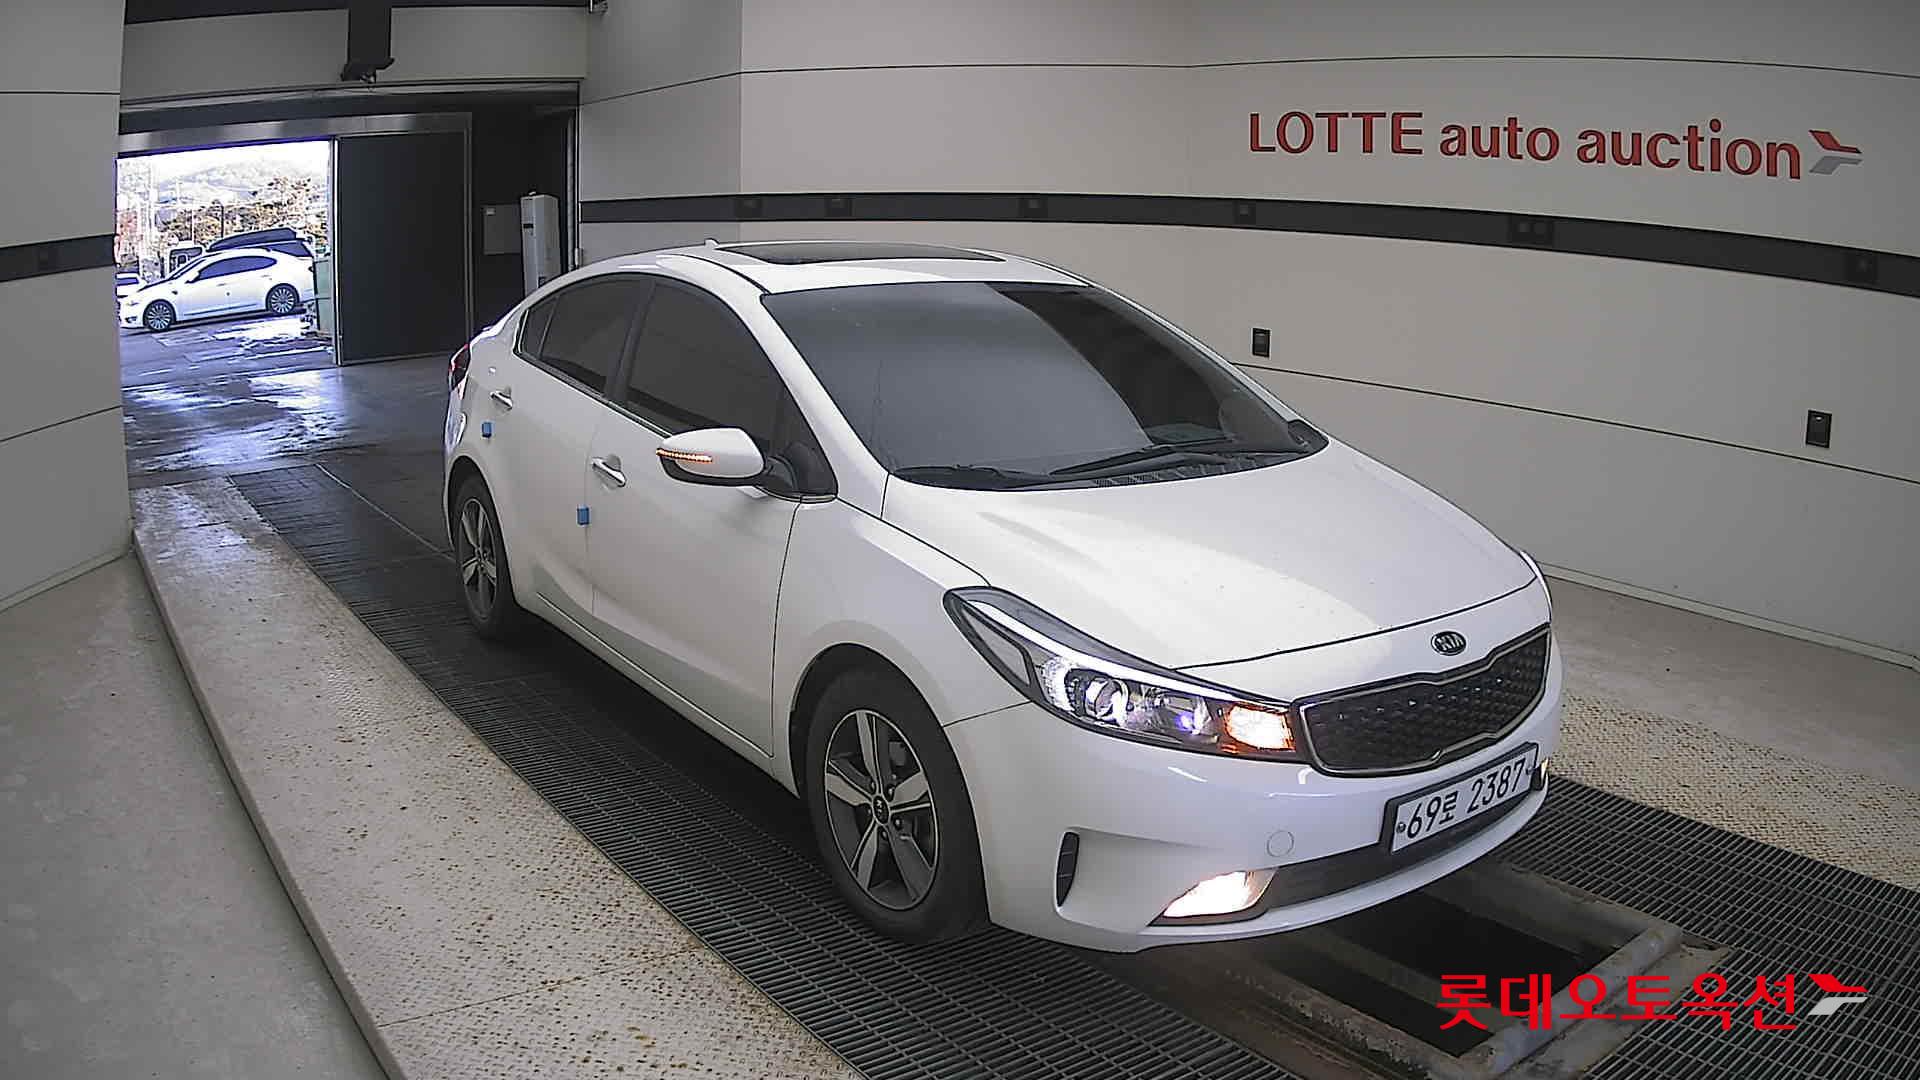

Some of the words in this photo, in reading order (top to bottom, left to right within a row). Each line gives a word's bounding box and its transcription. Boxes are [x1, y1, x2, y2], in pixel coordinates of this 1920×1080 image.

[1249, 112, 1424, 155] LOTTE
[1439, 117, 1560, 162] auto
[1576, 118, 1801, 180] auction
[1435, 633, 1464, 651] KIA
[1407, 790, 1459, 839] 69로
[1466, 758, 1526, 813] 2387
